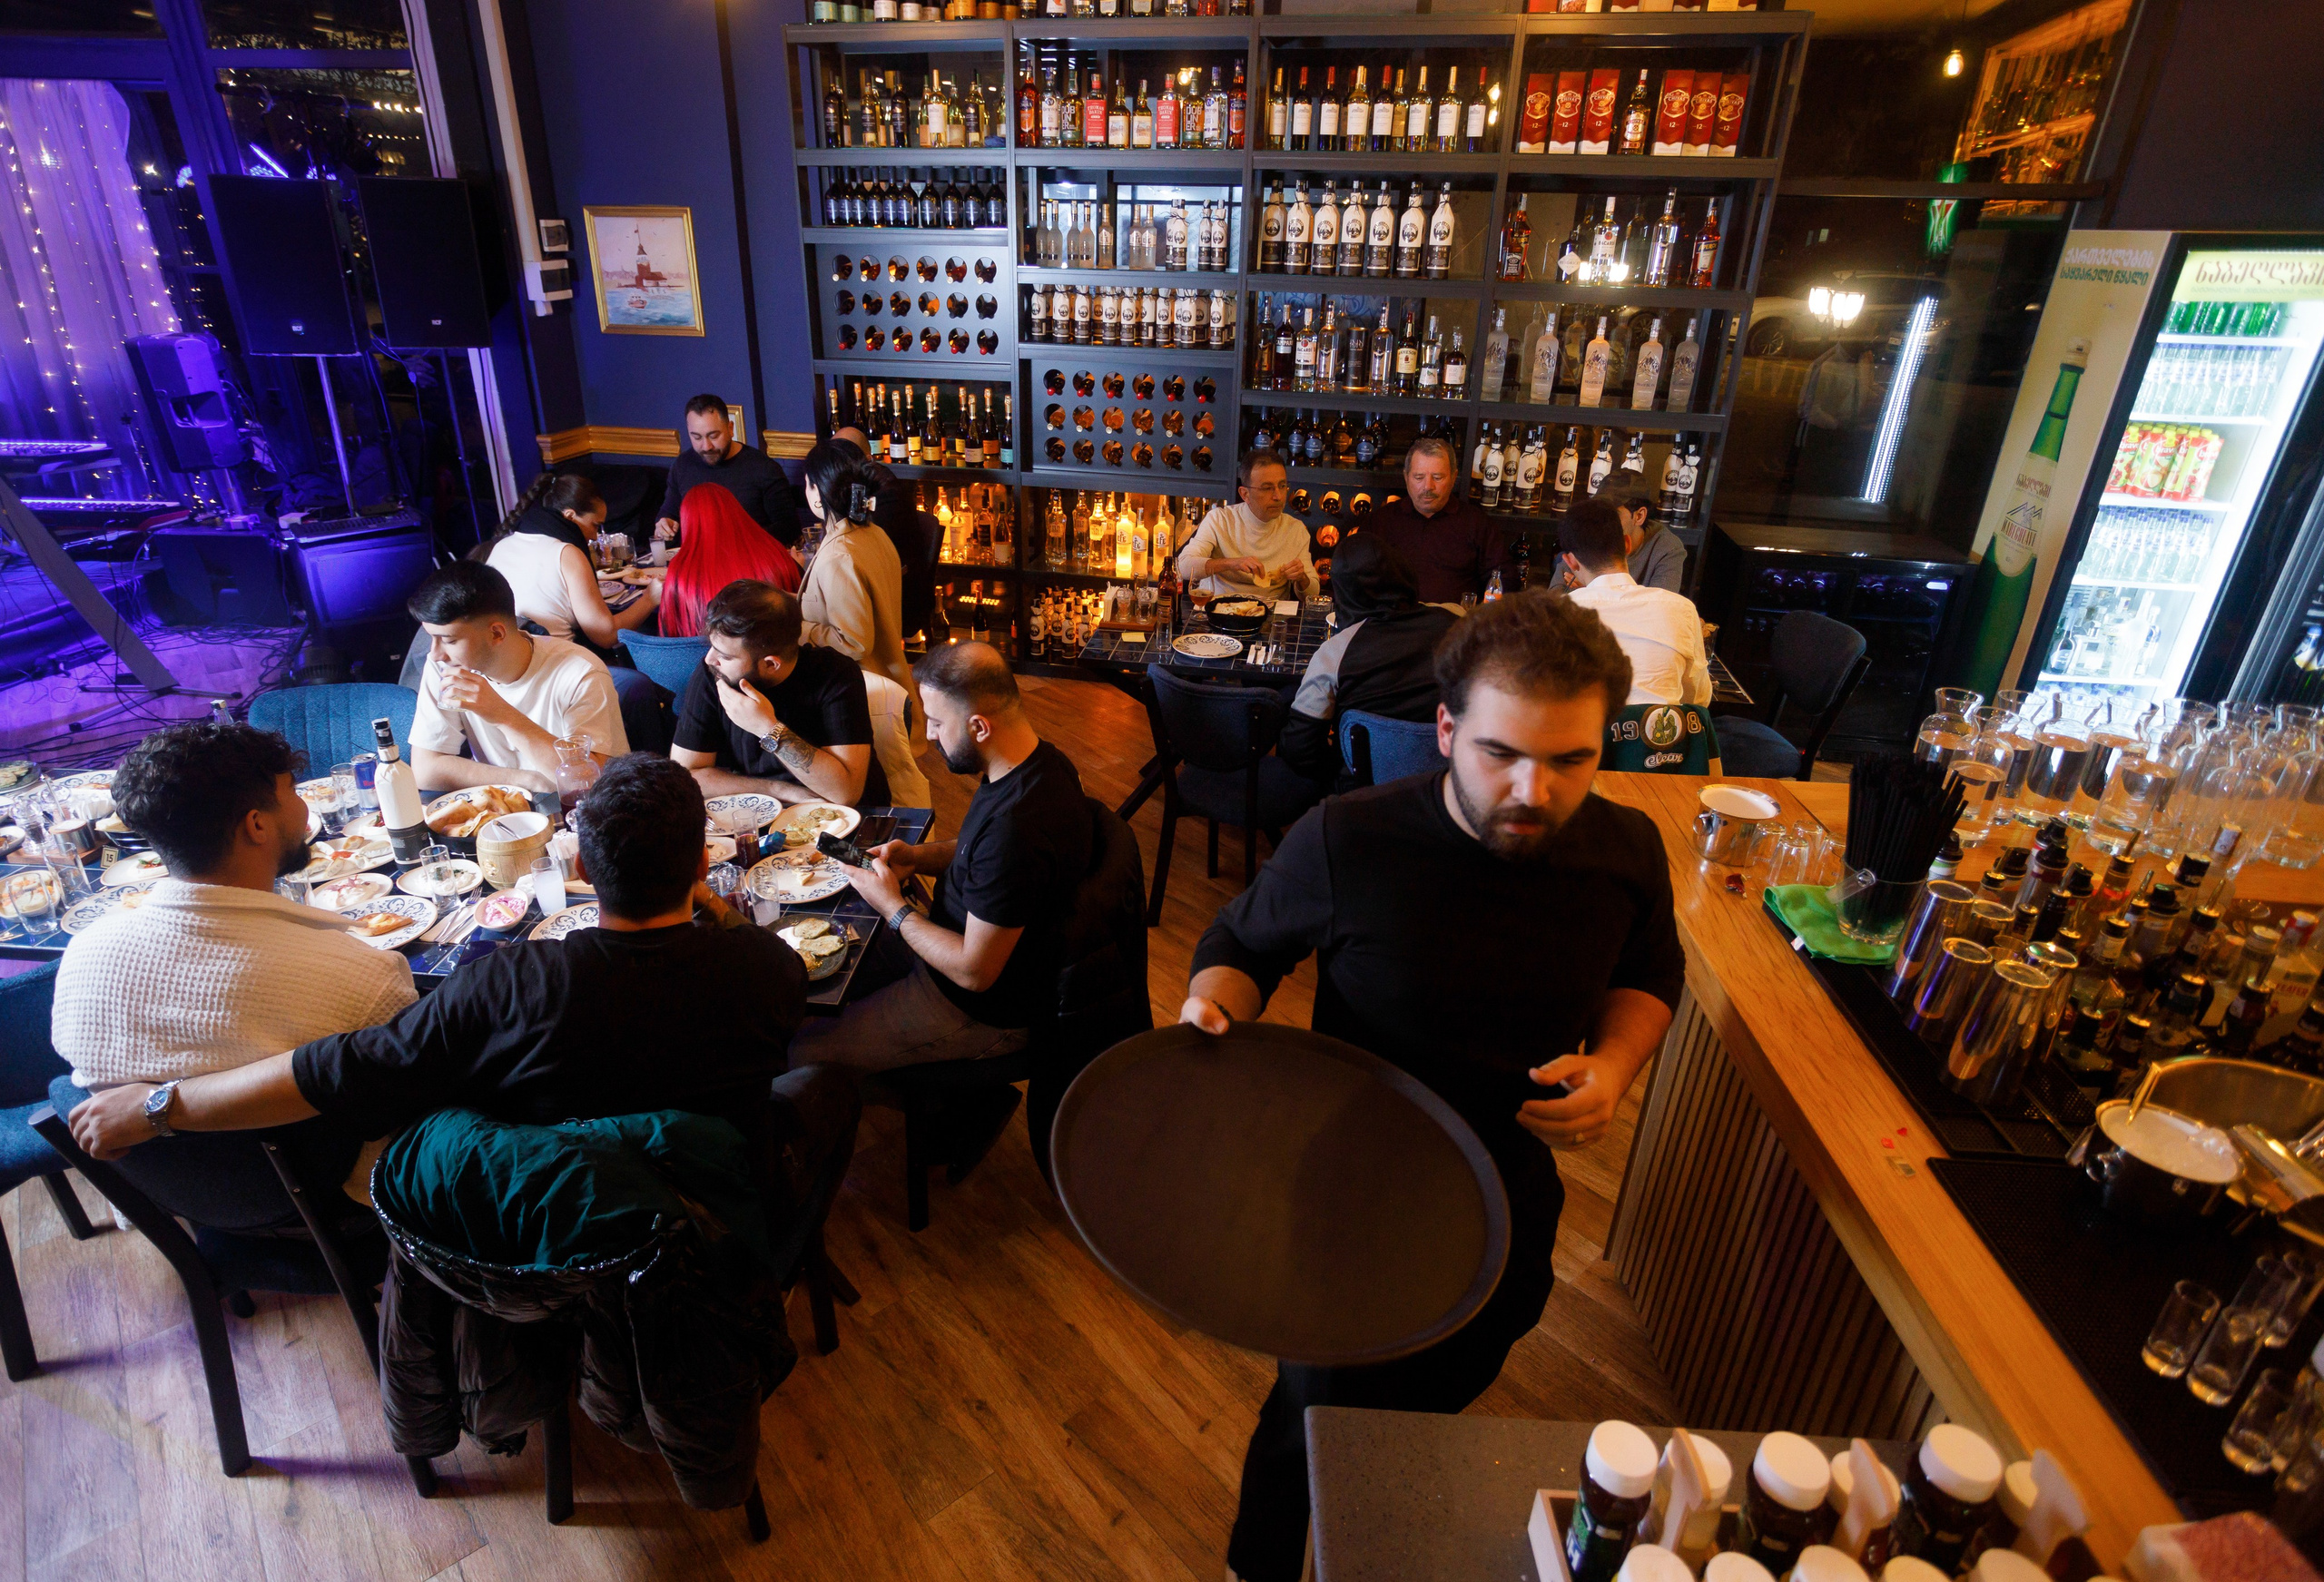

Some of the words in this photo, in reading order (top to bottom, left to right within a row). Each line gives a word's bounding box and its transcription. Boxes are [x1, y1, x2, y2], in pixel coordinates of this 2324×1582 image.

[1610, 720, 1640, 742] 19
[1686, 711, 1706, 733] 8
[105, 853, 113, 863] 15
